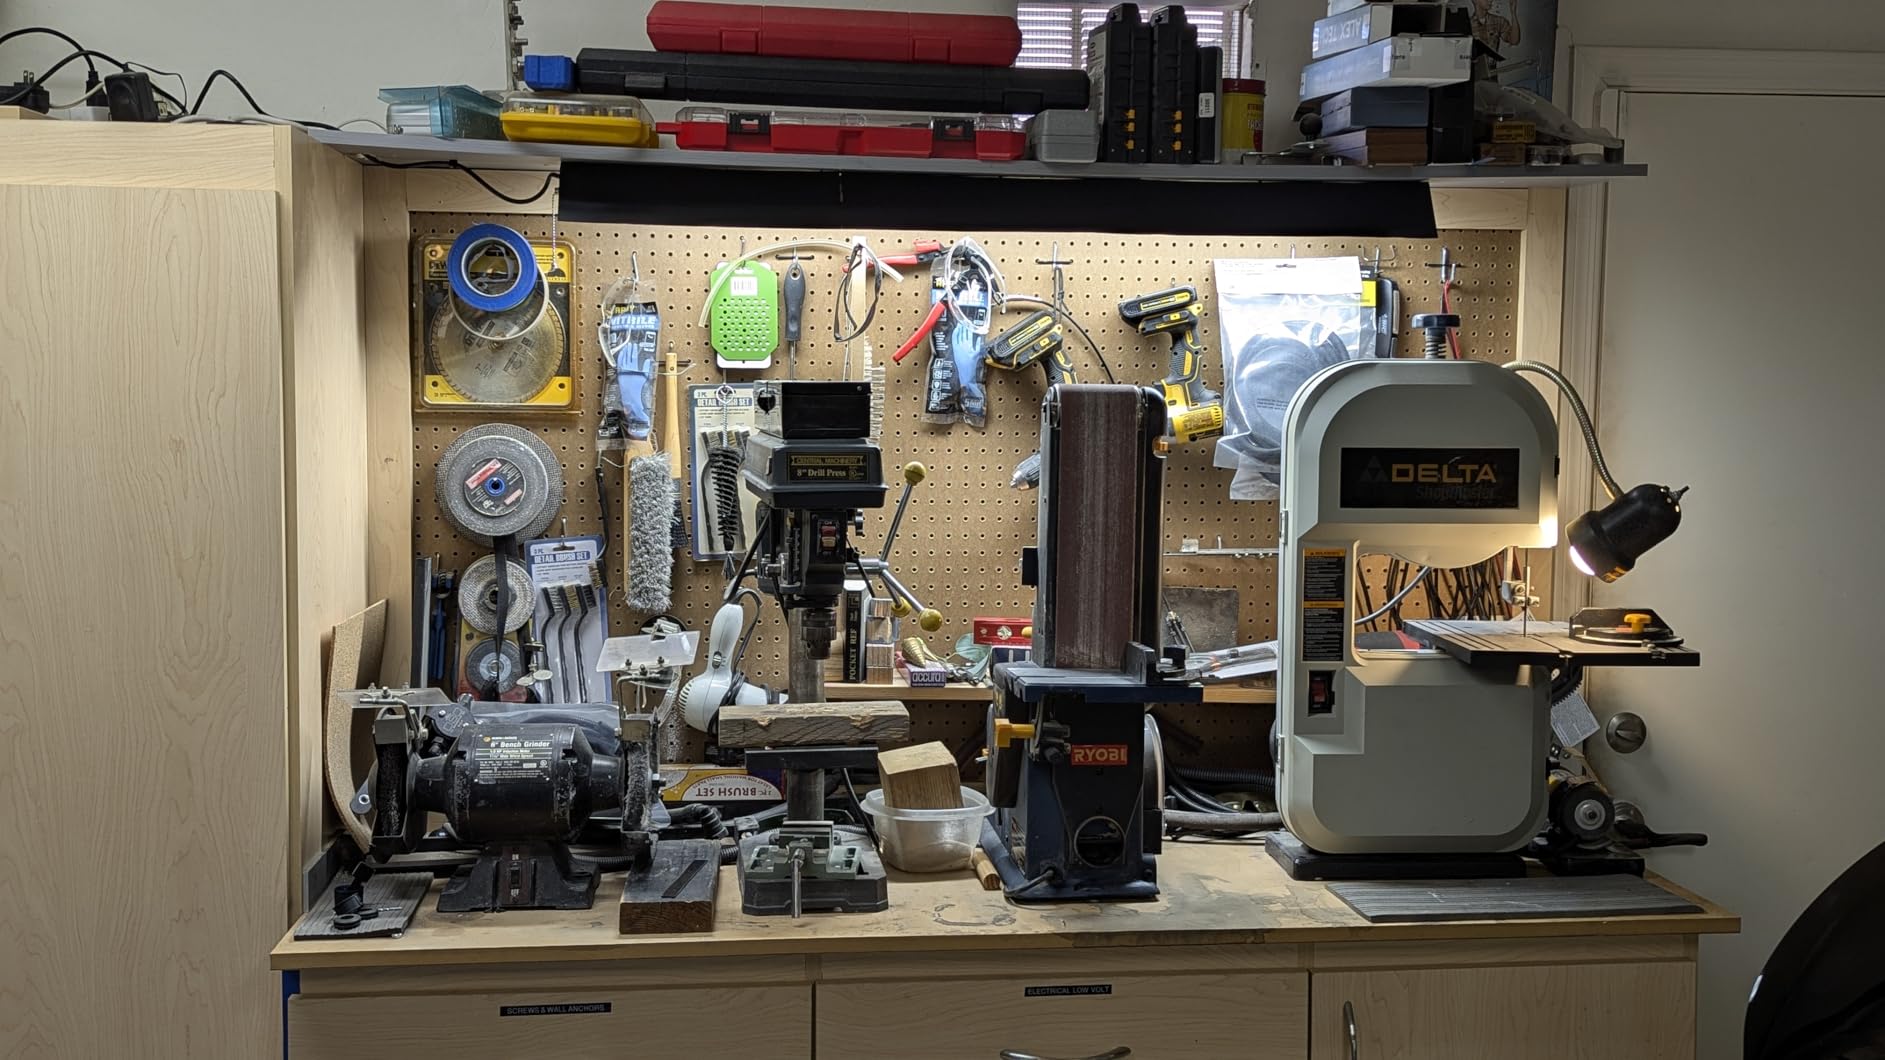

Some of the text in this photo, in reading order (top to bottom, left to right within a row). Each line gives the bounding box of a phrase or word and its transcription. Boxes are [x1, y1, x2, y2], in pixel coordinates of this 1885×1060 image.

[1392, 464, 1497, 482] DELTA
[1074, 748, 1127, 762] RYOBI
[696, 788, 714, 796] SET
[718, 788, 756, 796] BRUSH
[568, 1004, 605, 1012] ANCHORS
